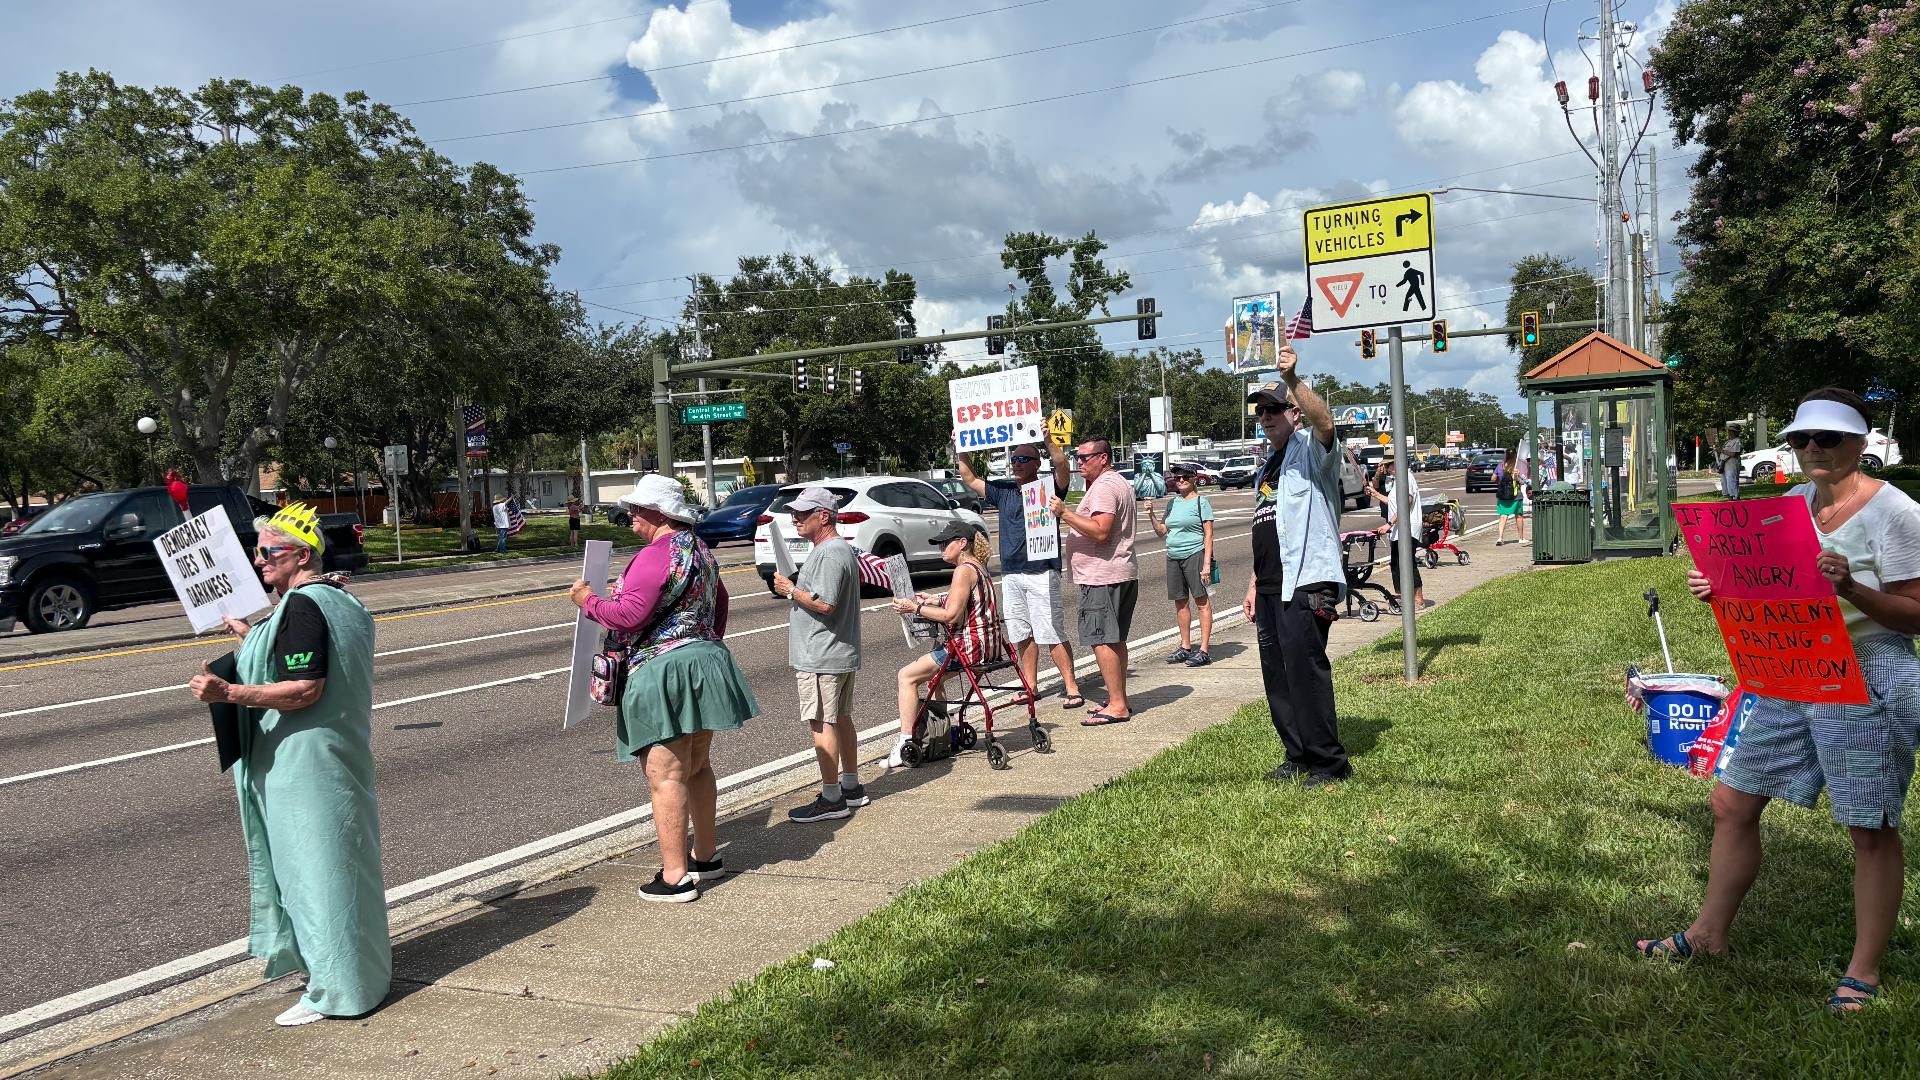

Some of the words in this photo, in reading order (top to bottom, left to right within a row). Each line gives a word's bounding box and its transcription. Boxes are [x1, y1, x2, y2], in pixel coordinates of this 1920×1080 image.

[1314, 209, 1380, 230] TURNING
[1315, 232, 1384, 253] VEHICLES
[1369, 285, 1387, 299] TO
[955, 379, 991, 400] SHOW
[1000, 372, 1030, 393] THE
[957, 397, 1039, 423] EPSTEIN
[960, 424, 1013, 447] FILES!
[1024, 487, 1036, 507] NO
[1677, 507, 1702, 527] IF
[1711, 505, 1749, 529] YOU
[160, 514, 212, 557] DEMOCRACY
[176, 553, 200, 579] DIES
[198, 546, 216, 570] IN
[185, 572, 233, 608] DARKNESS
[1715, 600, 1755, 623] YOU
[1739, 630, 1814, 650] PAYING
[1668, 703, 1694, 717] DO
[1699, 704, 1713, 718] IT
